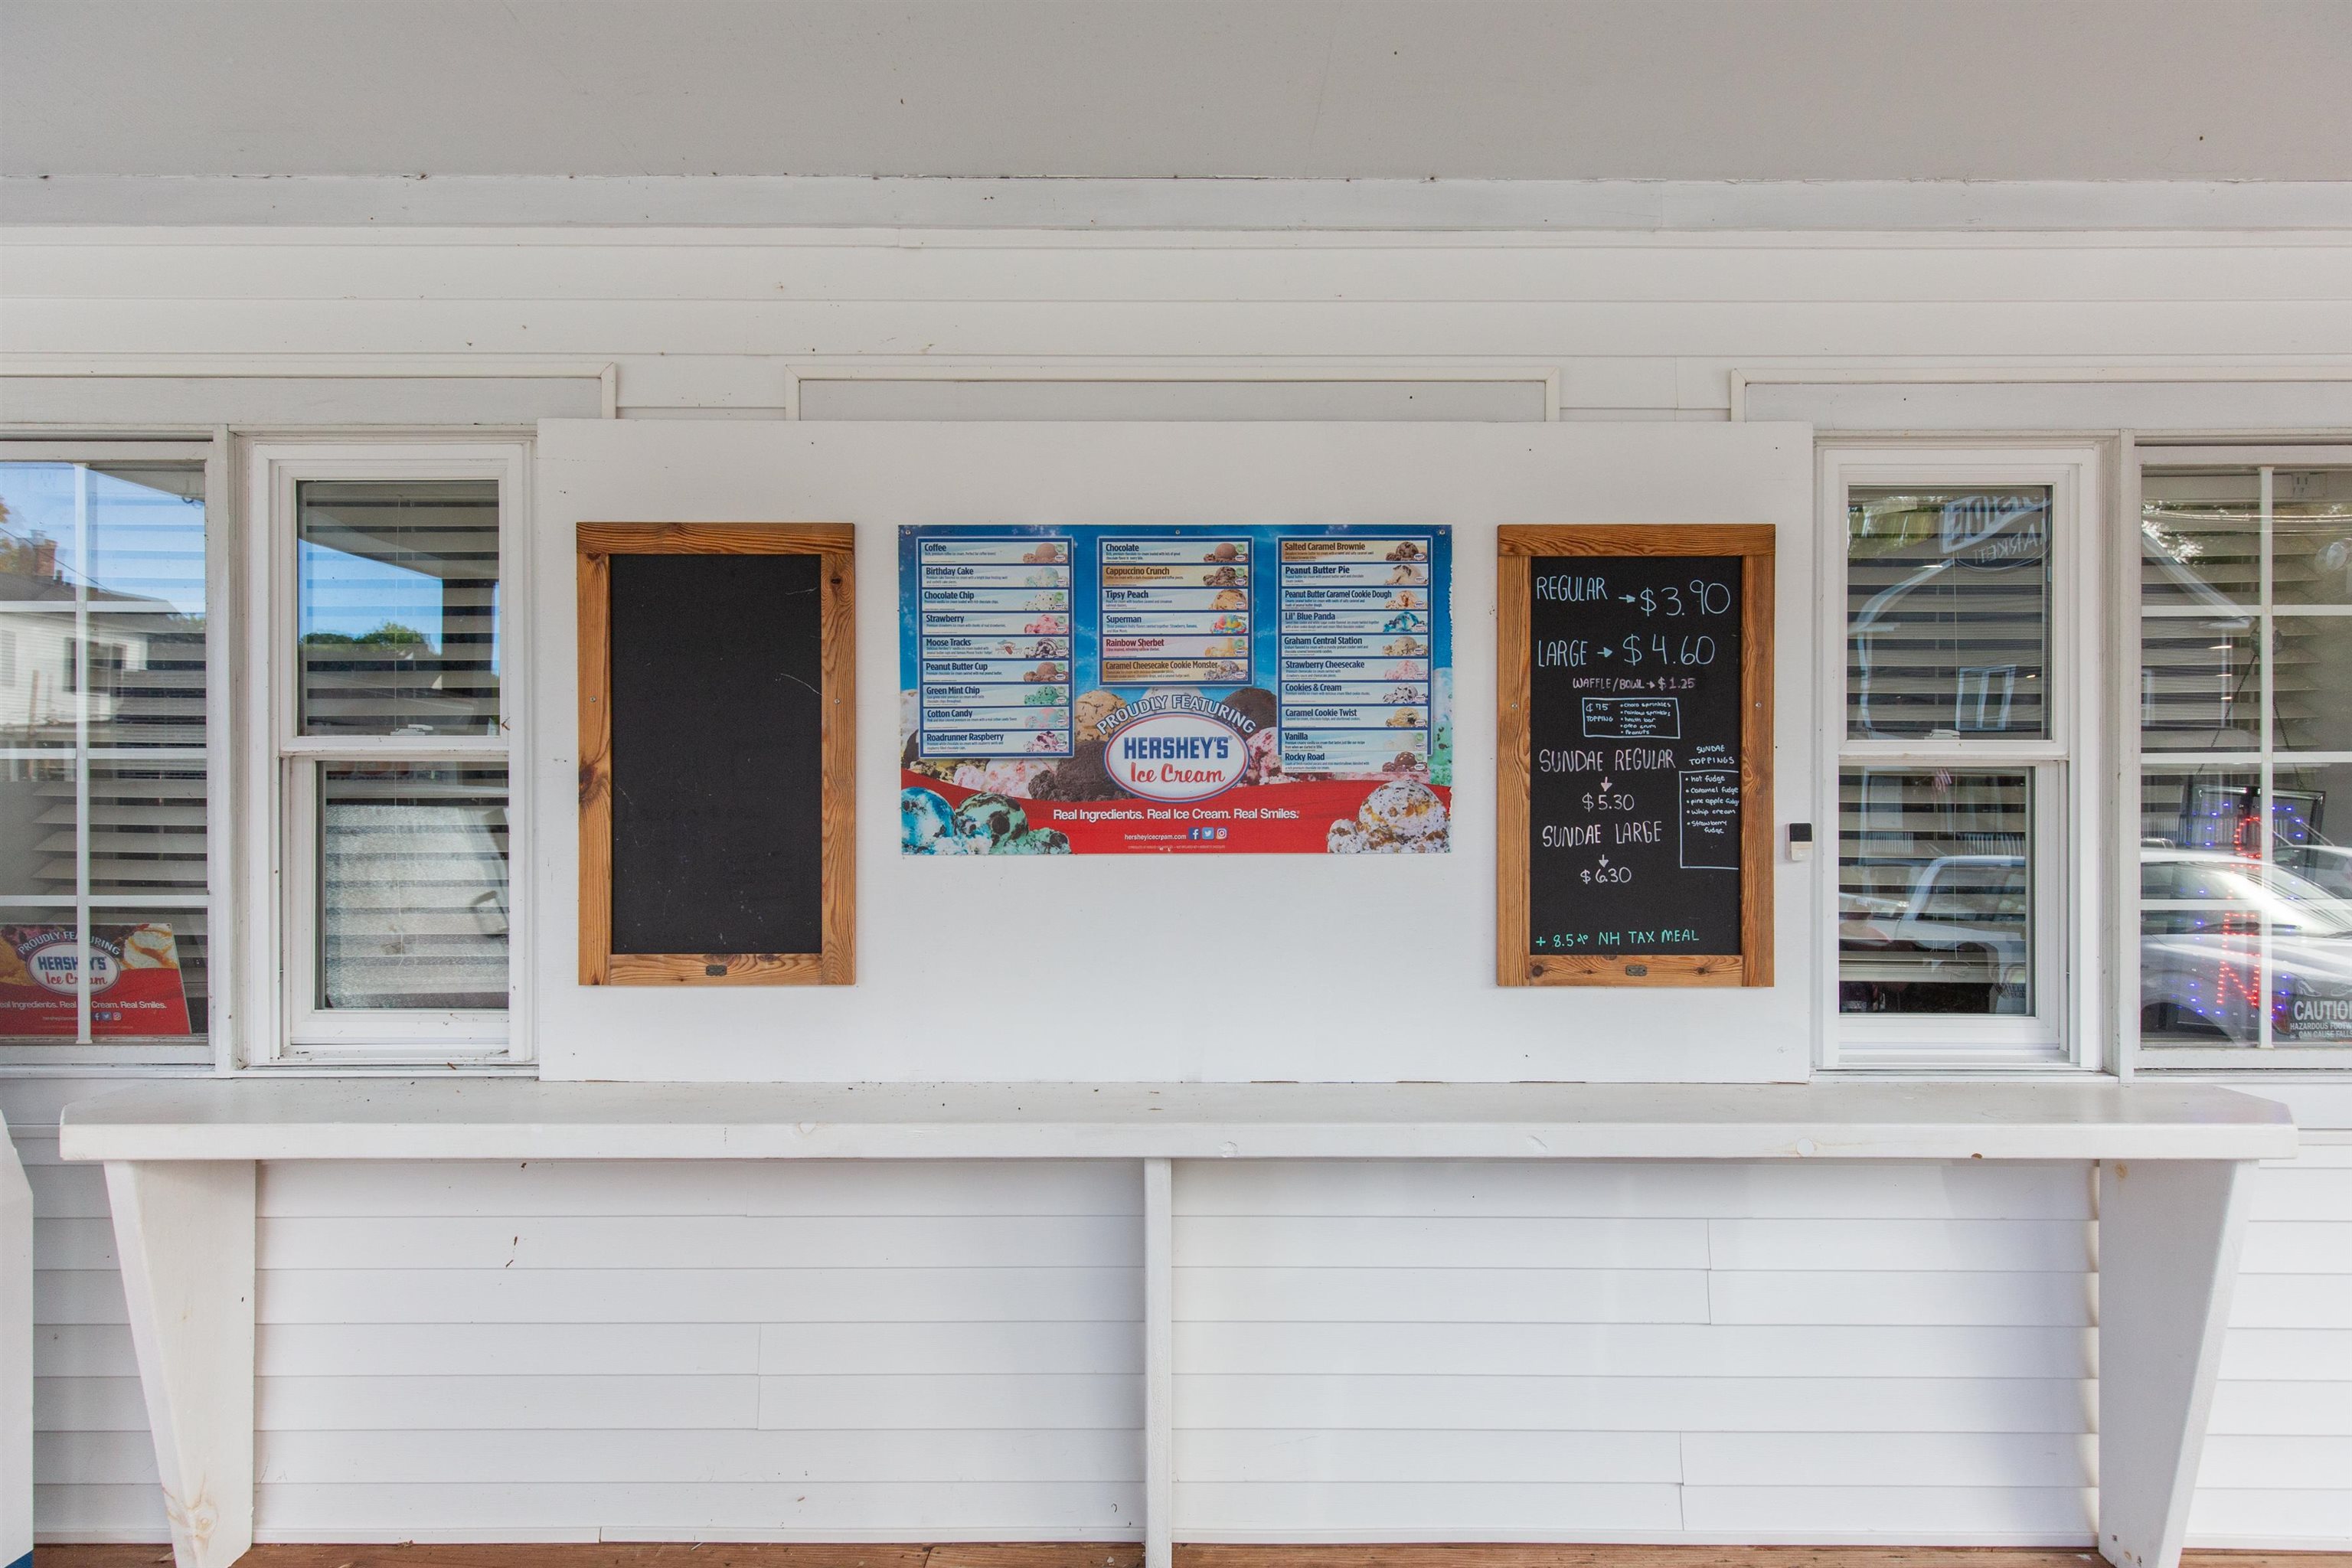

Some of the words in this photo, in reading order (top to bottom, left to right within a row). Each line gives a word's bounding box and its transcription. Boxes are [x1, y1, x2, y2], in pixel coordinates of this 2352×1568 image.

[1308, 542, 1335, 550] Caramel
[1337, 542, 1366, 550] Brownie
[926, 567, 956, 576] Birthday
[1106, 567, 1145, 576] Cappuccino
[1146, 567, 1170, 575] Crunch
[1312, 566, 1336, 574] Butter
[1338, 566, 1350, 574] Pie
[959, 591, 975, 600] Chip
[1106, 590, 1125, 599] Tipsy
[1351, 590, 1371, 598] Cookie
[1372, 590, 1392, 599] Dough
[1537, 575, 1608, 601] REGULAR
[1640, 580, 1730, 616] $3.90
[926, 615, 965, 623] Strawberry
[1106, 616, 1142, 624] Superman
[1314, 612, 1336, 620] Panda
[1138, 638, 1165, 647] Sherbet
[1312, 636, 1337, 645] Central
[1338, 636, 1362, 645] Station
[1538, 640, 1588, 667] LARGE
[926, 662, 950, 671] Peanut
[952, 662, 973, 671] Butter
[975, 662, 988, 671] Cup
[1106, 662, 1132, 670] Caramel
[1170, 661, 1191, 669] Cookie
[1285, 661, 1324, 669] Strawberry
[1325, 660, 1365, 668] Cheesecake
[1658, 677, 1696, 691] $1.25
[949, 686, 963, 694] Mint
[965, 686, 980, 695] Chip
[927, 710, 950, 718] Cotton
[952, 710, 972, 718] Candy
[1095, 695, 1168, 735] PROUDLY
[1171, 694, 1256, 733] FEATURING
[1315, 708, 1338, 717] Cookie
[1340, 708, 1357, 717] Twist
[969, 733, 1004, 742] Raspberry
[1285, 732, 1308, 740] Vanilla
[1124, 737, 1229, 759] HERSHEY'S
[1697, 745, 1725, 754] SUNDAE
[1285, 753, 1305, 762] Rocky
[1539, 749, 1603, 773] SUNDAE
[1615, 748, 1676, 771] REGULAR
[1688, 756, 1735, 765] TOPPINGS
[1131, 762, 1157, 782] Ice
[1161, 763, 1225, 782] Cream
[1704, 775, 1726, 784] fudge
[1721, 786, 1739, 795] fudge
[1582, 792, 1635, 812] $5.30
[1054, 809, 1078, 820] Real
[1080, 809, 1144, 822] Ingredients.
[1147, 809, 1171, 819] Real
[1173, 809, 1189, 819] Ice
[1191, 809, 1230, 819] Cream.
[1233, 808, 1257, 818] Real
[1259, 808, 1298, 818] Smiles.
[1542, 824, 1601, 848] SUNDAE
[1615, 821, 1661, 844] LARGE
[1580, 867, 1632, 884] $6.30
[1599, 932, 1620, 946] NH
[1628, 931, 1655, 944] TAX
[1661, 929, 1700, 943] MEAL
[18, 931, 60, 955] PROUDLY
[63, 931, 121, 956] FEAURING
[38, 956, 107, 970] HERSHY'S
[45, 972, 64, 985] Ice
